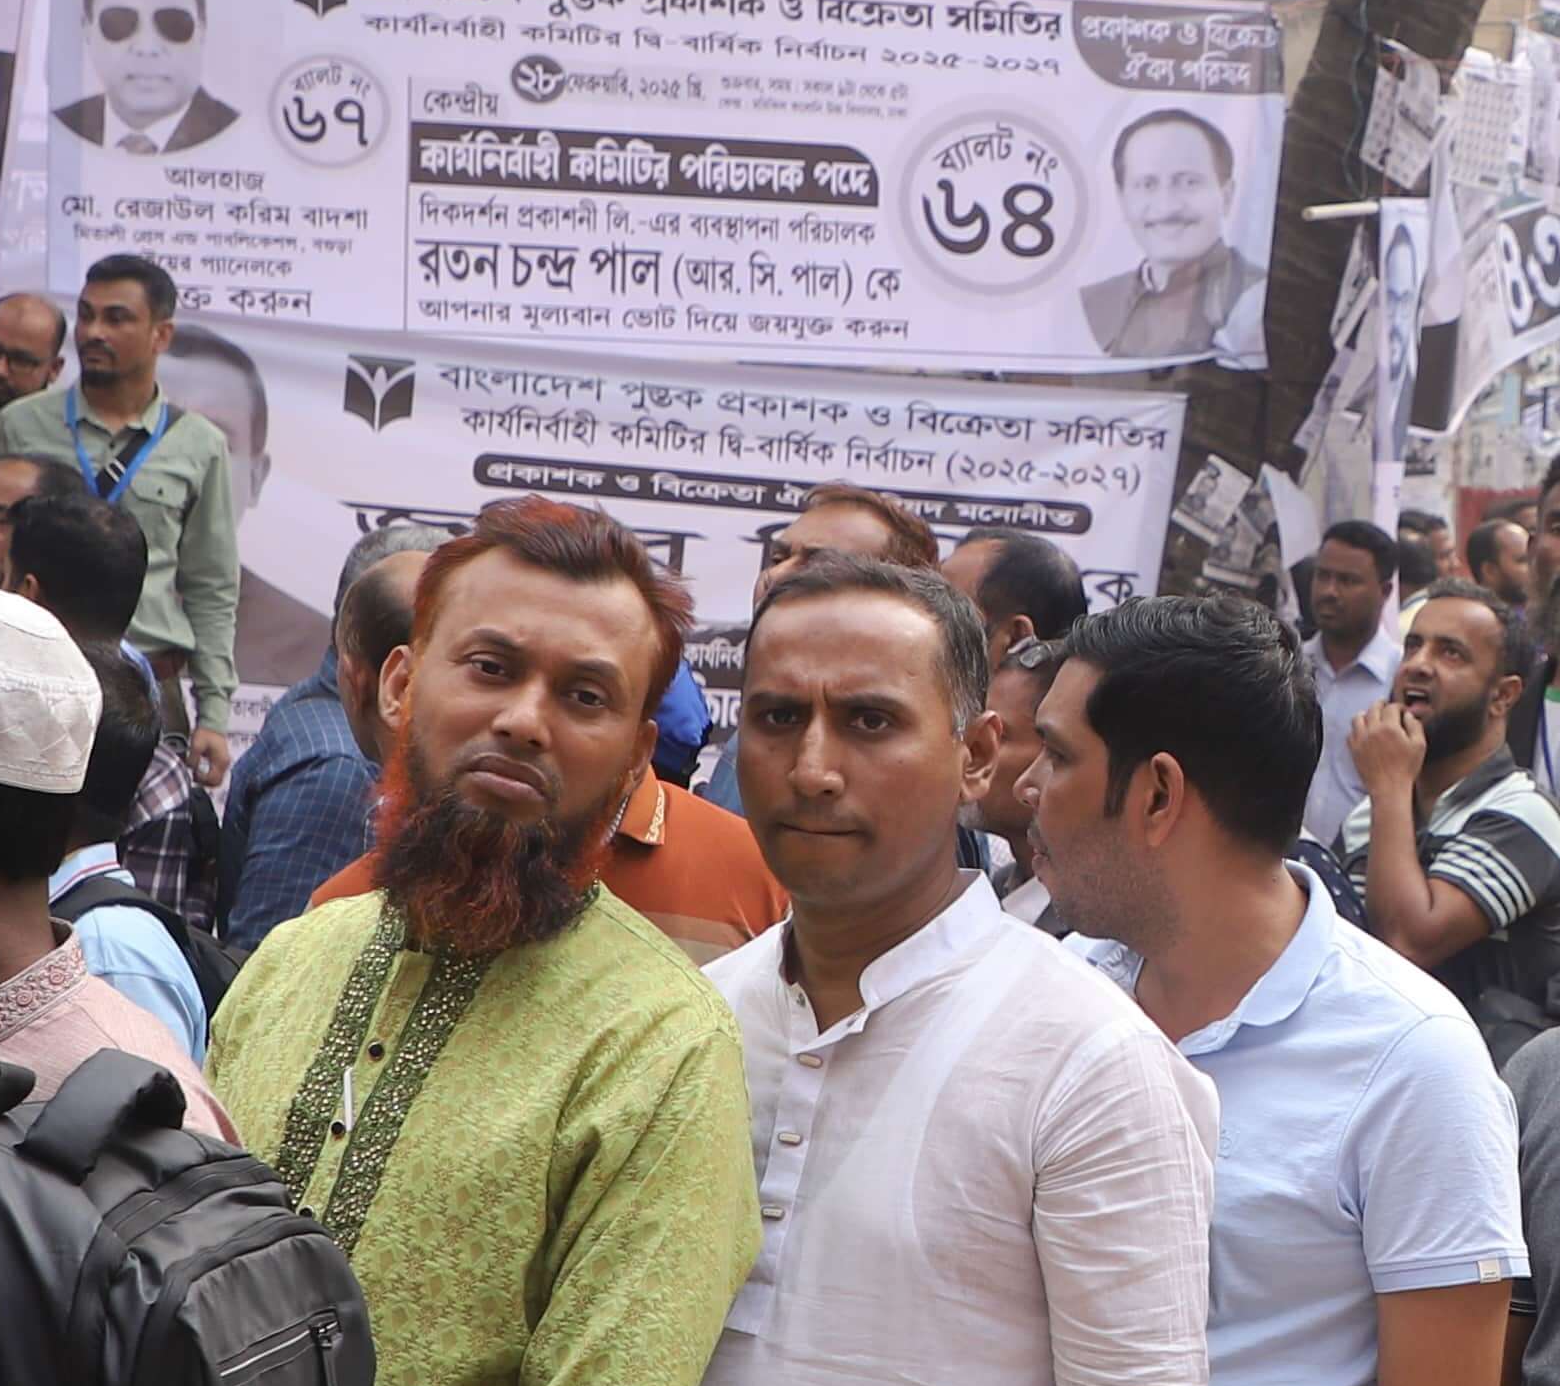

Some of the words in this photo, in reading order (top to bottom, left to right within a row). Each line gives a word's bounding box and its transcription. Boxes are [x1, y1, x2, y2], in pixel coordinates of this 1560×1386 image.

[365, 12, 505, 40] কার্যনির্বাহী
[521, 22, 620, 47] কমিটির
[776, 37, 866, 62] নির্বাচন
[282, 95, 368, 146] ৬৭
[424, 82, 500, 116] কেন্দ্রীয়
[420, 131, 560, 183] কার্যনির্বাহী
[570, 137, 671, 190] কমিটির
[680, 142, 806, 195] পরিচালক
[813, 160, 871, 197] পদে
[933, 122, 1014, 172] ব্যালট
[1026, 141, 1058, 182] নং
[165, 167, 265, 192] আলহাজ
[115, 194, 214, 223] রেজাউল
[226, 197, 290, 224] করিম
[302, 206, 368, 230] বাদশা
[420, 193, 507, 228] দিকদর্শন
[517, 199, 596, 233] প্রকাশনী
[789, 213, 875, 246] পরিচালক
[922, 178, 1055, 258] ৬৪
[415, 239, 500, 290] রতন
[509, 243, 579, 293] চন্দ্র
[590, 241, 662, 296] পাল
[866, 268, 902, 301] কে
[229, 286, 312, 316] করুন
[419, 300, 510, 323] আপনার
[523, 304, 610, 331] মূল্যবান
[623, 303, 676, 330] ভোট
[687, 304, 737, 333] দিয়ে
[749, 314, 832, 340] জয়যুক্ত
[845, 318, 909, 339] করুন
[439, 365, 604, 403] বাংলাদেশ
[620, 380, 705, 413] পুস্তক
[717, 389, 849, 425] প্রকাশক
[865, 407, 891, 427] ও
[906, 401, 1034, 442] বিক্রেতা
[1047, 415, 1170, 451] সমিতির
[460, 405, 600, 446] কার্যনির্বাহী
[609, 417, 707, 457] কমিটির
[720, 424, 837, 464] দ্বি-বার্ষিক
[846, 435, 936, 475] নির্বাচন
[946, 451, 1142, 495] (২০২৫-২০২৭)
[485, 461, 606, 490] প্রকাশক
[651, 471, 767, 506] বিক্রেতা
